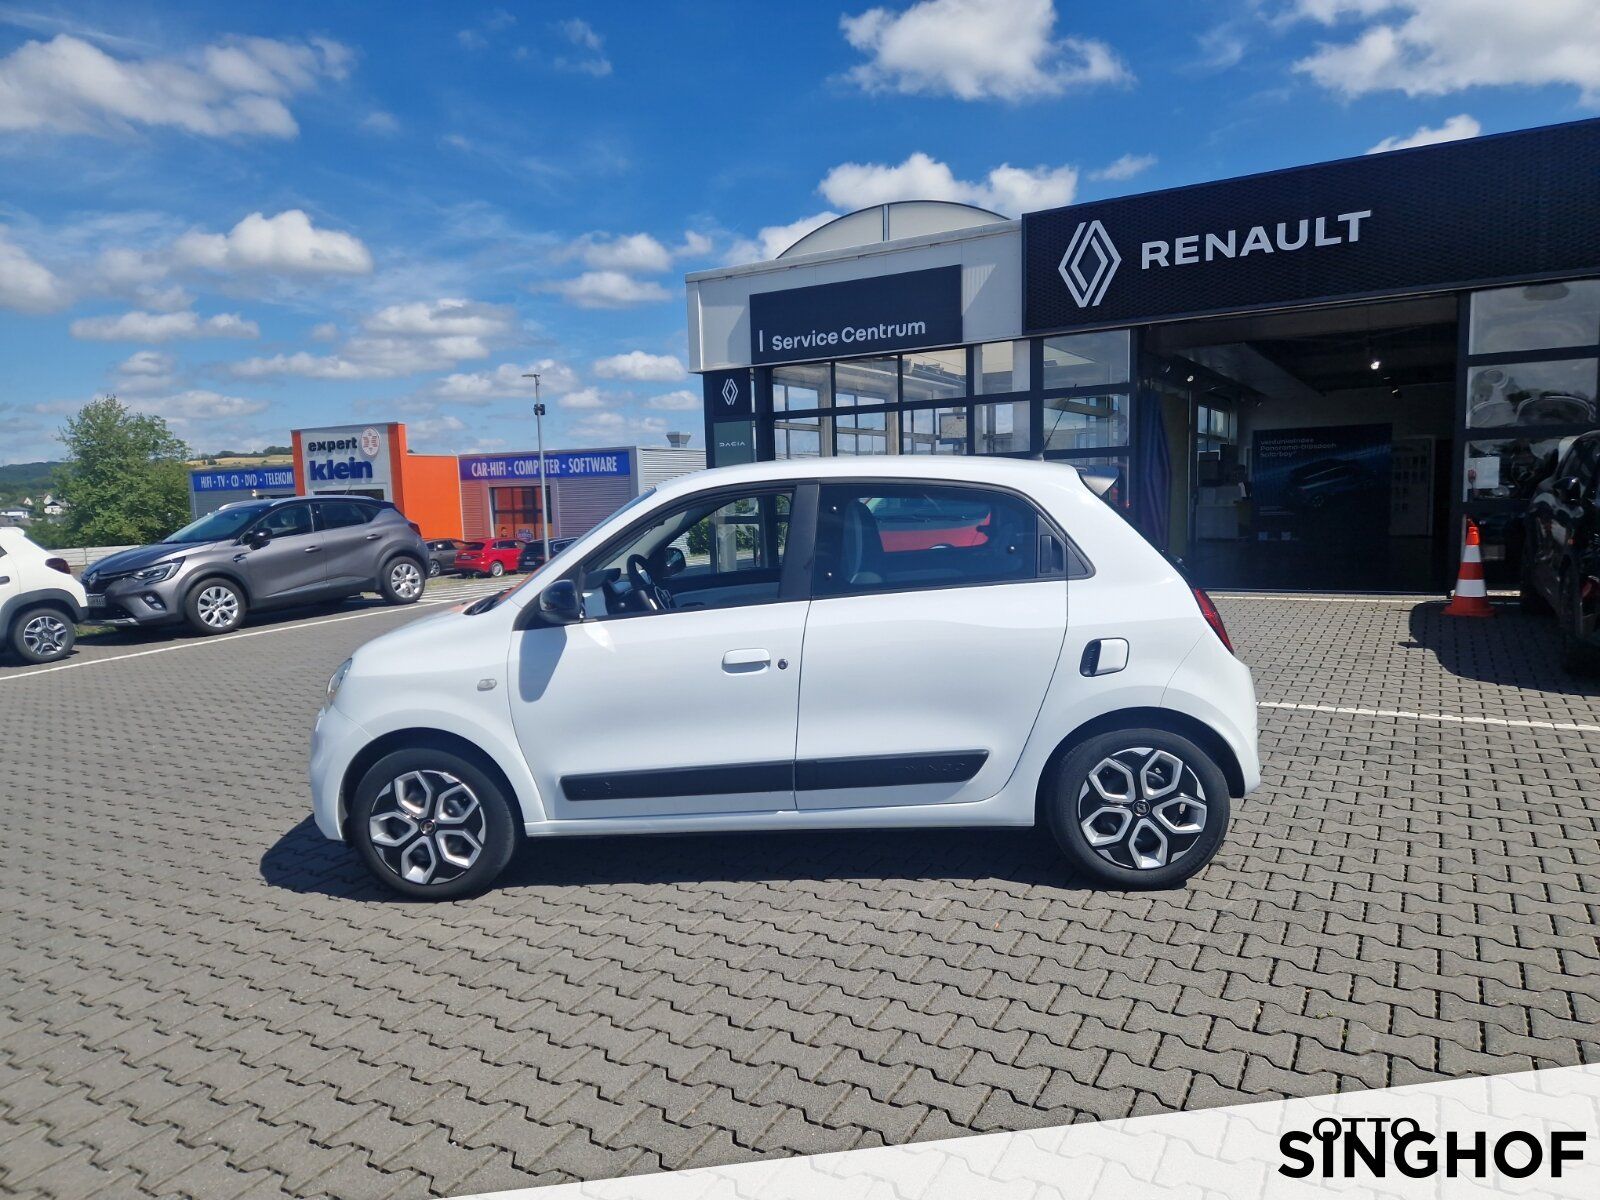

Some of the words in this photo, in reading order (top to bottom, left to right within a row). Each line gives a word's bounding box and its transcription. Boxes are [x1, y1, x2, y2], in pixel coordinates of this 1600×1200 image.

[1141, 209, 1372, 270] RENAULT
[772, 330, 838, 351] Service
[841, 321, 926, 343] Centrum
[307, 436, 358, 453] expert
[308, 456, 373, 481] klein
[471, 462, 507, 477] CAR-HIFI
[568, 456, 617, 474] SOFTWARE
[200, 475, 213, 488] HIFI
[217, 475, 225, 487] TV
[230, 474, 239, 487] CD
[244, 473, 258, 487] DVD
[265, 471, 293, 486] TELEKOM
